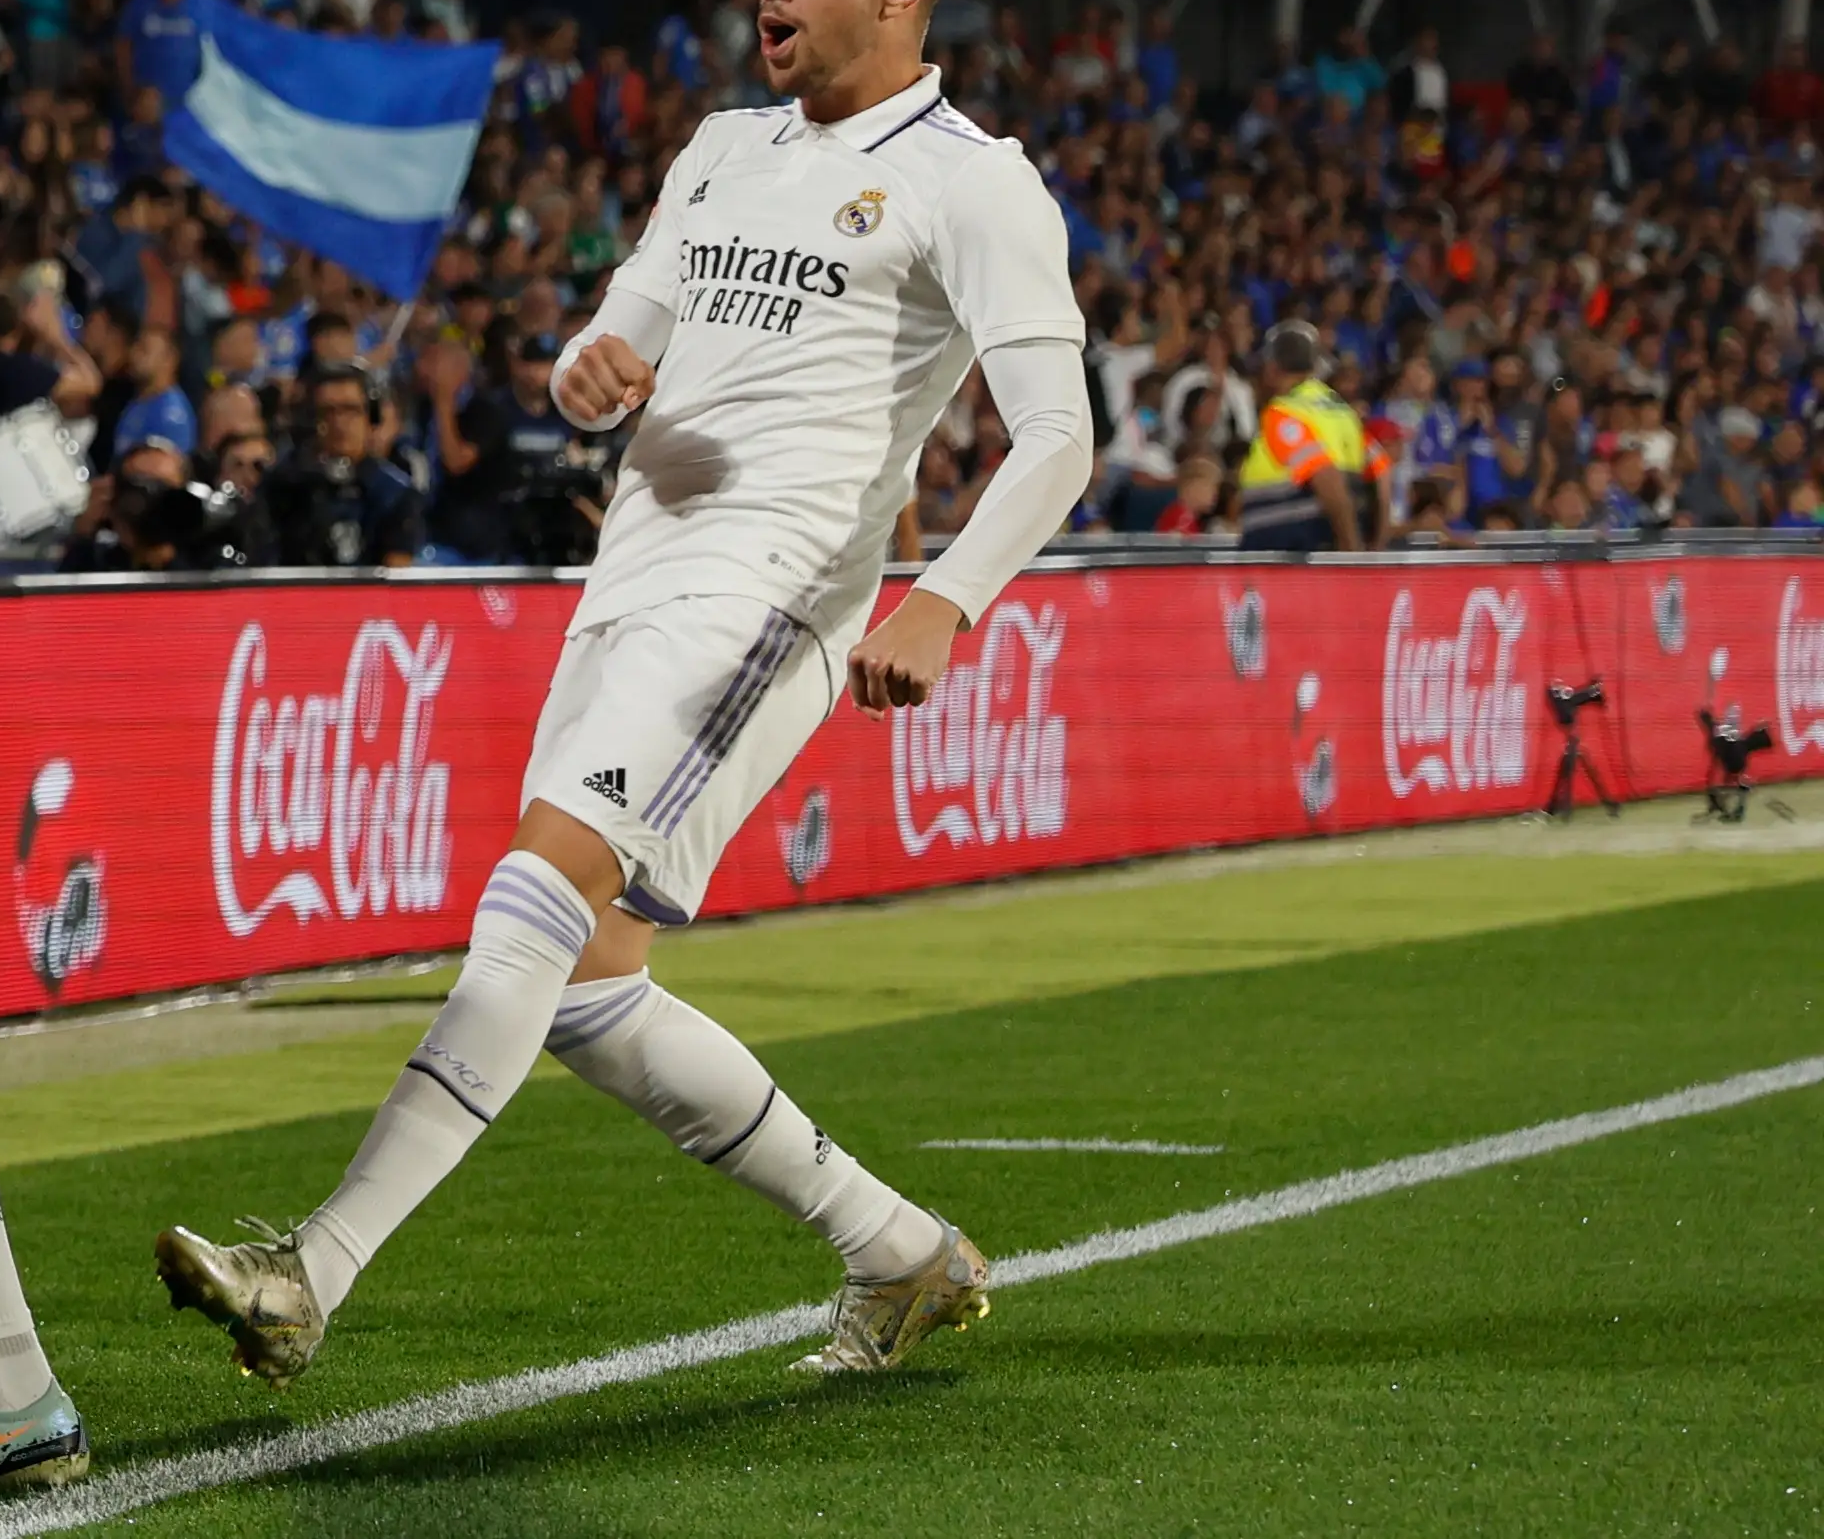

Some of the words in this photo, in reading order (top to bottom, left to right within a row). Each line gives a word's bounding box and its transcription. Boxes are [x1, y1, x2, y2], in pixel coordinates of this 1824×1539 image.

[706, 288, 803, 335] BETTER
[212, 619, 454, 938] Coca-Cola
[582, 777, 629, 809] adidas
